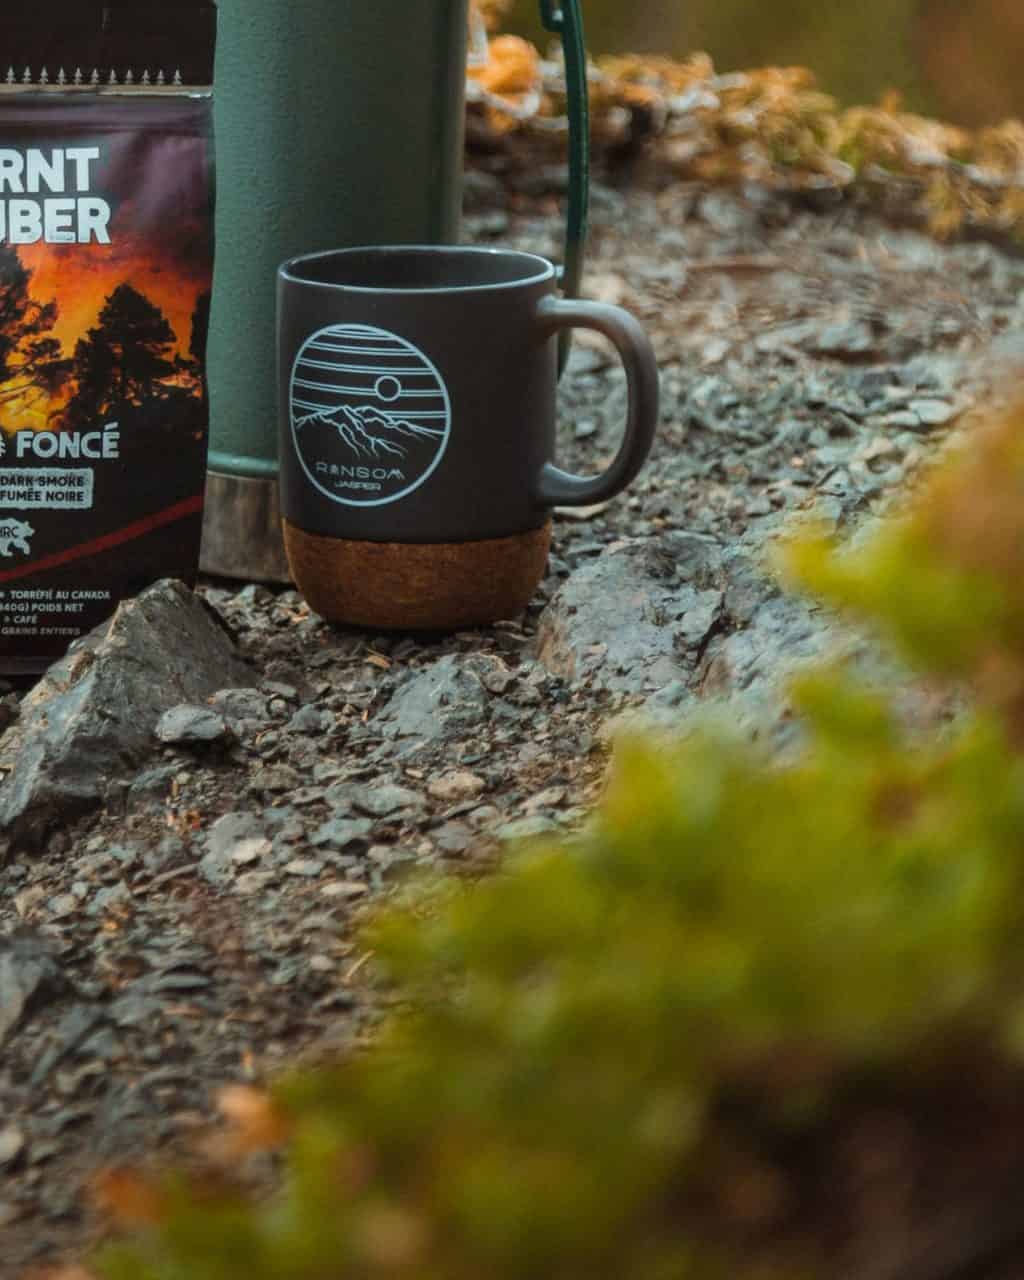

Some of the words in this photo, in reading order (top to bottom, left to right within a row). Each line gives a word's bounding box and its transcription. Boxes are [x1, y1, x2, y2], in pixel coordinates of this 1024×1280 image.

[16, 422, 121, 459] FONCÉ
[0, 476, 34, 487] DARK
[38, 476, 85, 487] SMOKE
[0, 488, 42, 502] FUMÉE
[45, 491, 85, 502] NOIRE
[55, 591, 70, 599] AU
[71, 591, 111, 600] CANADA
[31, 603, 63, 613] POIDS
[64, 603, 84, 613] NET
[13, 613, 38, 625] CAFÉ
